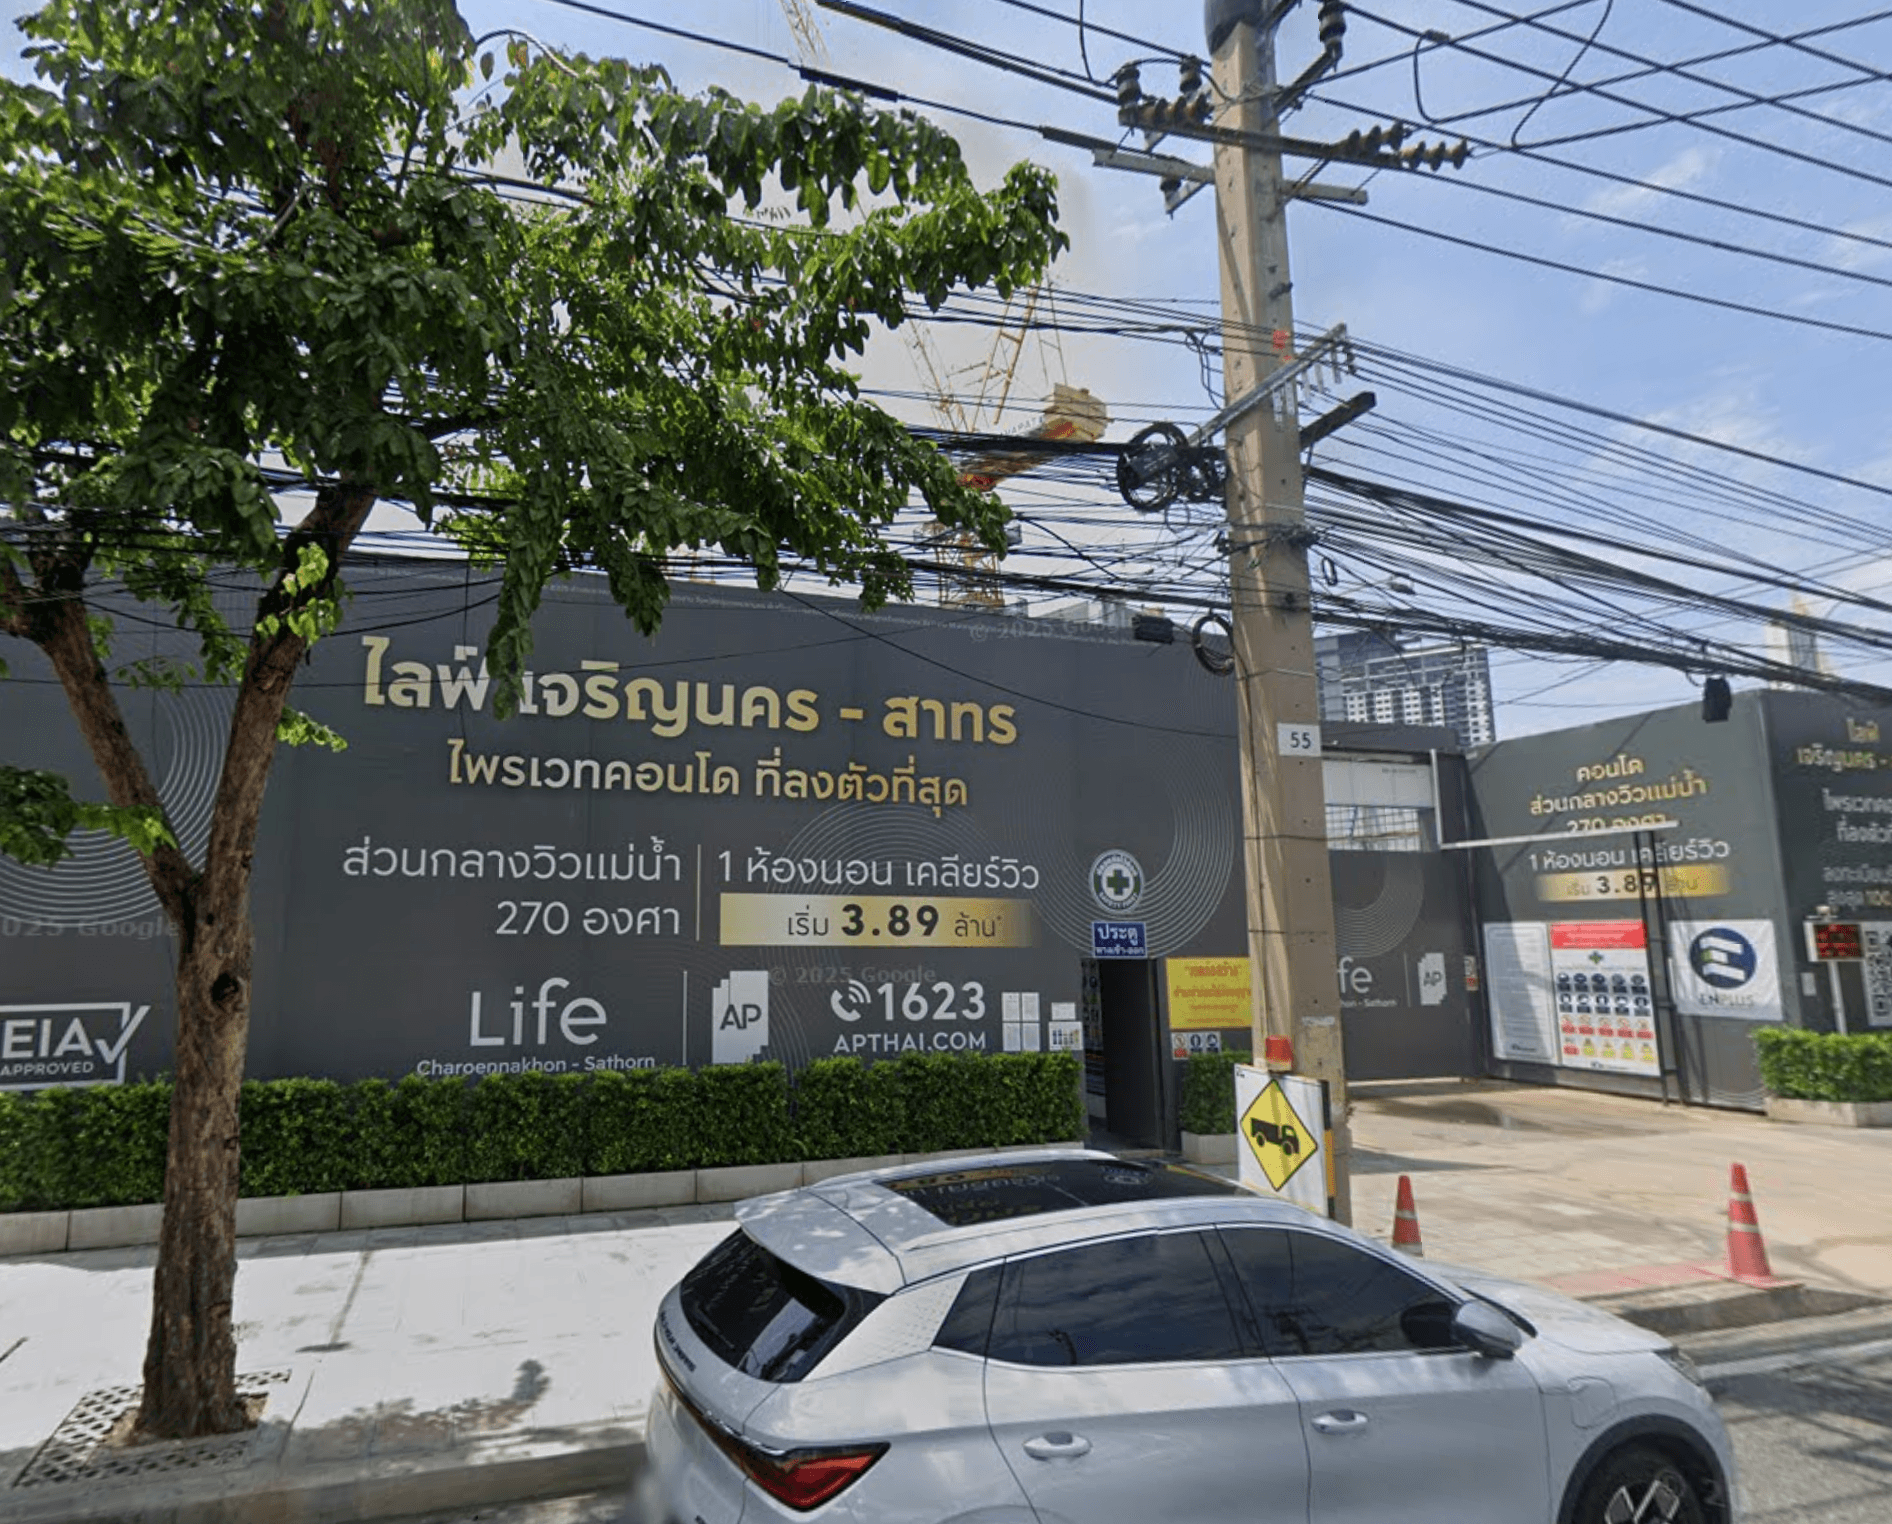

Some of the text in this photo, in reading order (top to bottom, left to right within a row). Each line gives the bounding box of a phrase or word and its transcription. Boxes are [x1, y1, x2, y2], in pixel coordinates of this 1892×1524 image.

[519, 659, 821, 738] เจริญนคร
[839, 707, 864, 720] -
[882, 696, 1017, 745] สาทร
[1290, 731, 1312, 750] 55
[447, 738, 968, 818] ไพรเวทคอนโด ที่ลงตัวที่สุด
[1530, 768, 1707, 815] ส่วนกลางวิวแม่น้ำ
[343, 836, 681, 882] ส่วนกลางวิวแม่น้ำ
[719, 846, 1039, 889] 1 ห้องนอน เคลียร์วิว
[1529, 853, 1538, 871] 1
[1543, 849, 1625, 869] ห้องนอน
[495, 901, 680, 936] 270 องศา
[788, 905, 829, 936] เริ่ม
[841, 904, 939, 937] 3.89
[1097, 923, 1139, 947] ประตู
[470, 977, 607, 1046] Life
[719, 1003, 762, 1031] AP
[877, 981, 986, 1022] 1623
[2, 1017, 94, 1059] EIA
[833, 1032, 987, 1053] APTHAI.COM
[1, 1061, 94, 1077] APPROVED
[416, 1057, 566, 1076] Charoennakhon
[584, 1053, 656, 1072] Sathorn
